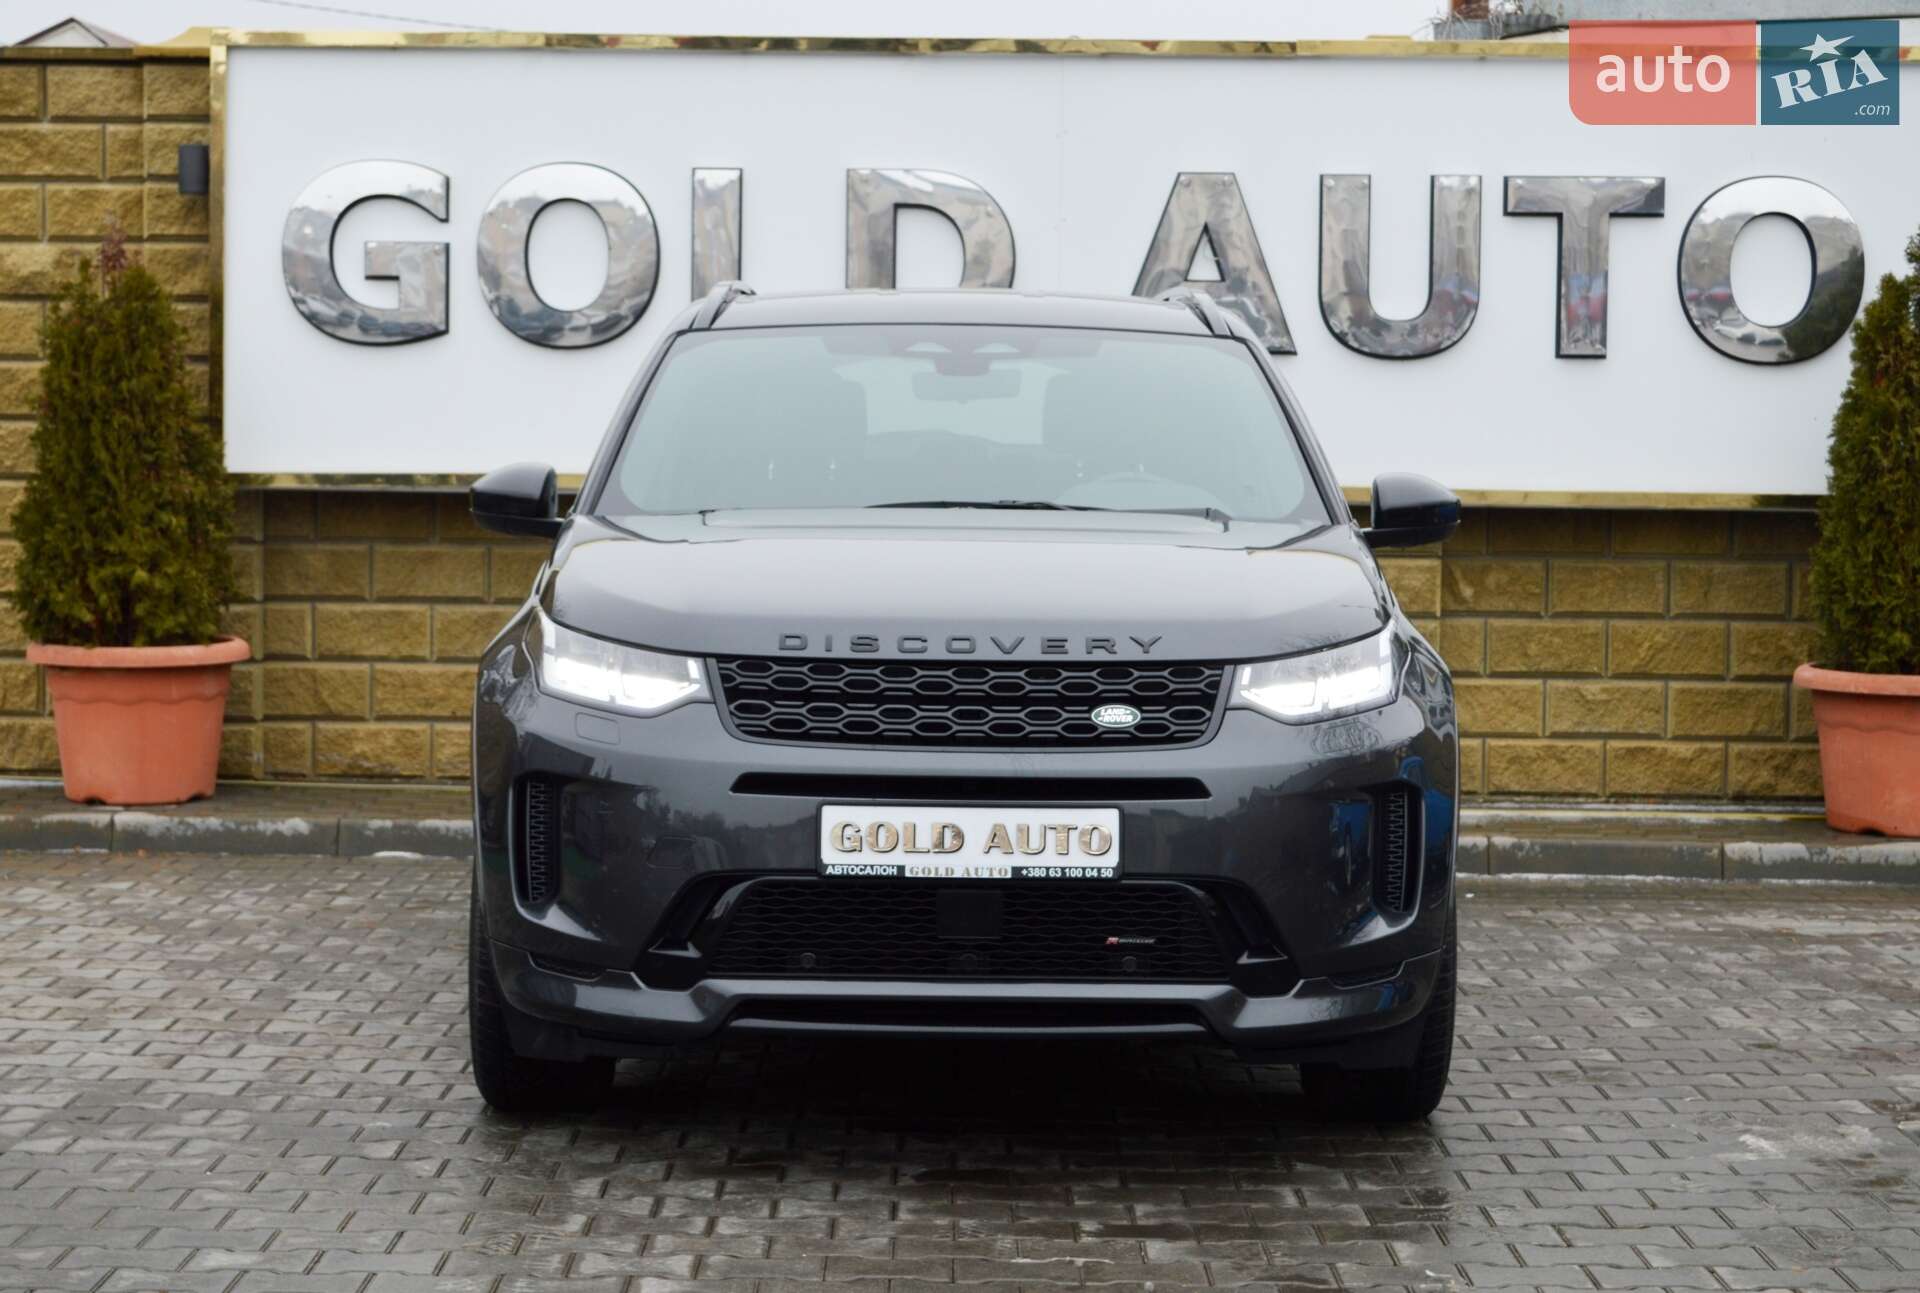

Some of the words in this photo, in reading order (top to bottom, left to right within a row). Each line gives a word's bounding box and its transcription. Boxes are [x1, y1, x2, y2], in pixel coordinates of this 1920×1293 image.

[1132, 171, 1866, 364] AUTO
[778, 632, 1163, 655] DISCOVERY
[830, 820, 965, 854] GOLD
[982, 822, 1112, 856] AUTO
[825, 865, 898, 876] АВТОСАЛОН
[909, 865, 956, 878] GOLD
[961, 865, 1010, 878] AUTO
[1020, 867, 1047, 878] +380
[1049, 867, 1062, 878] 63
[1064, 867, 1083, 878] 100
[1085, 867, 1099, 878] 04
[1100, 867, 1114, 878] 50
